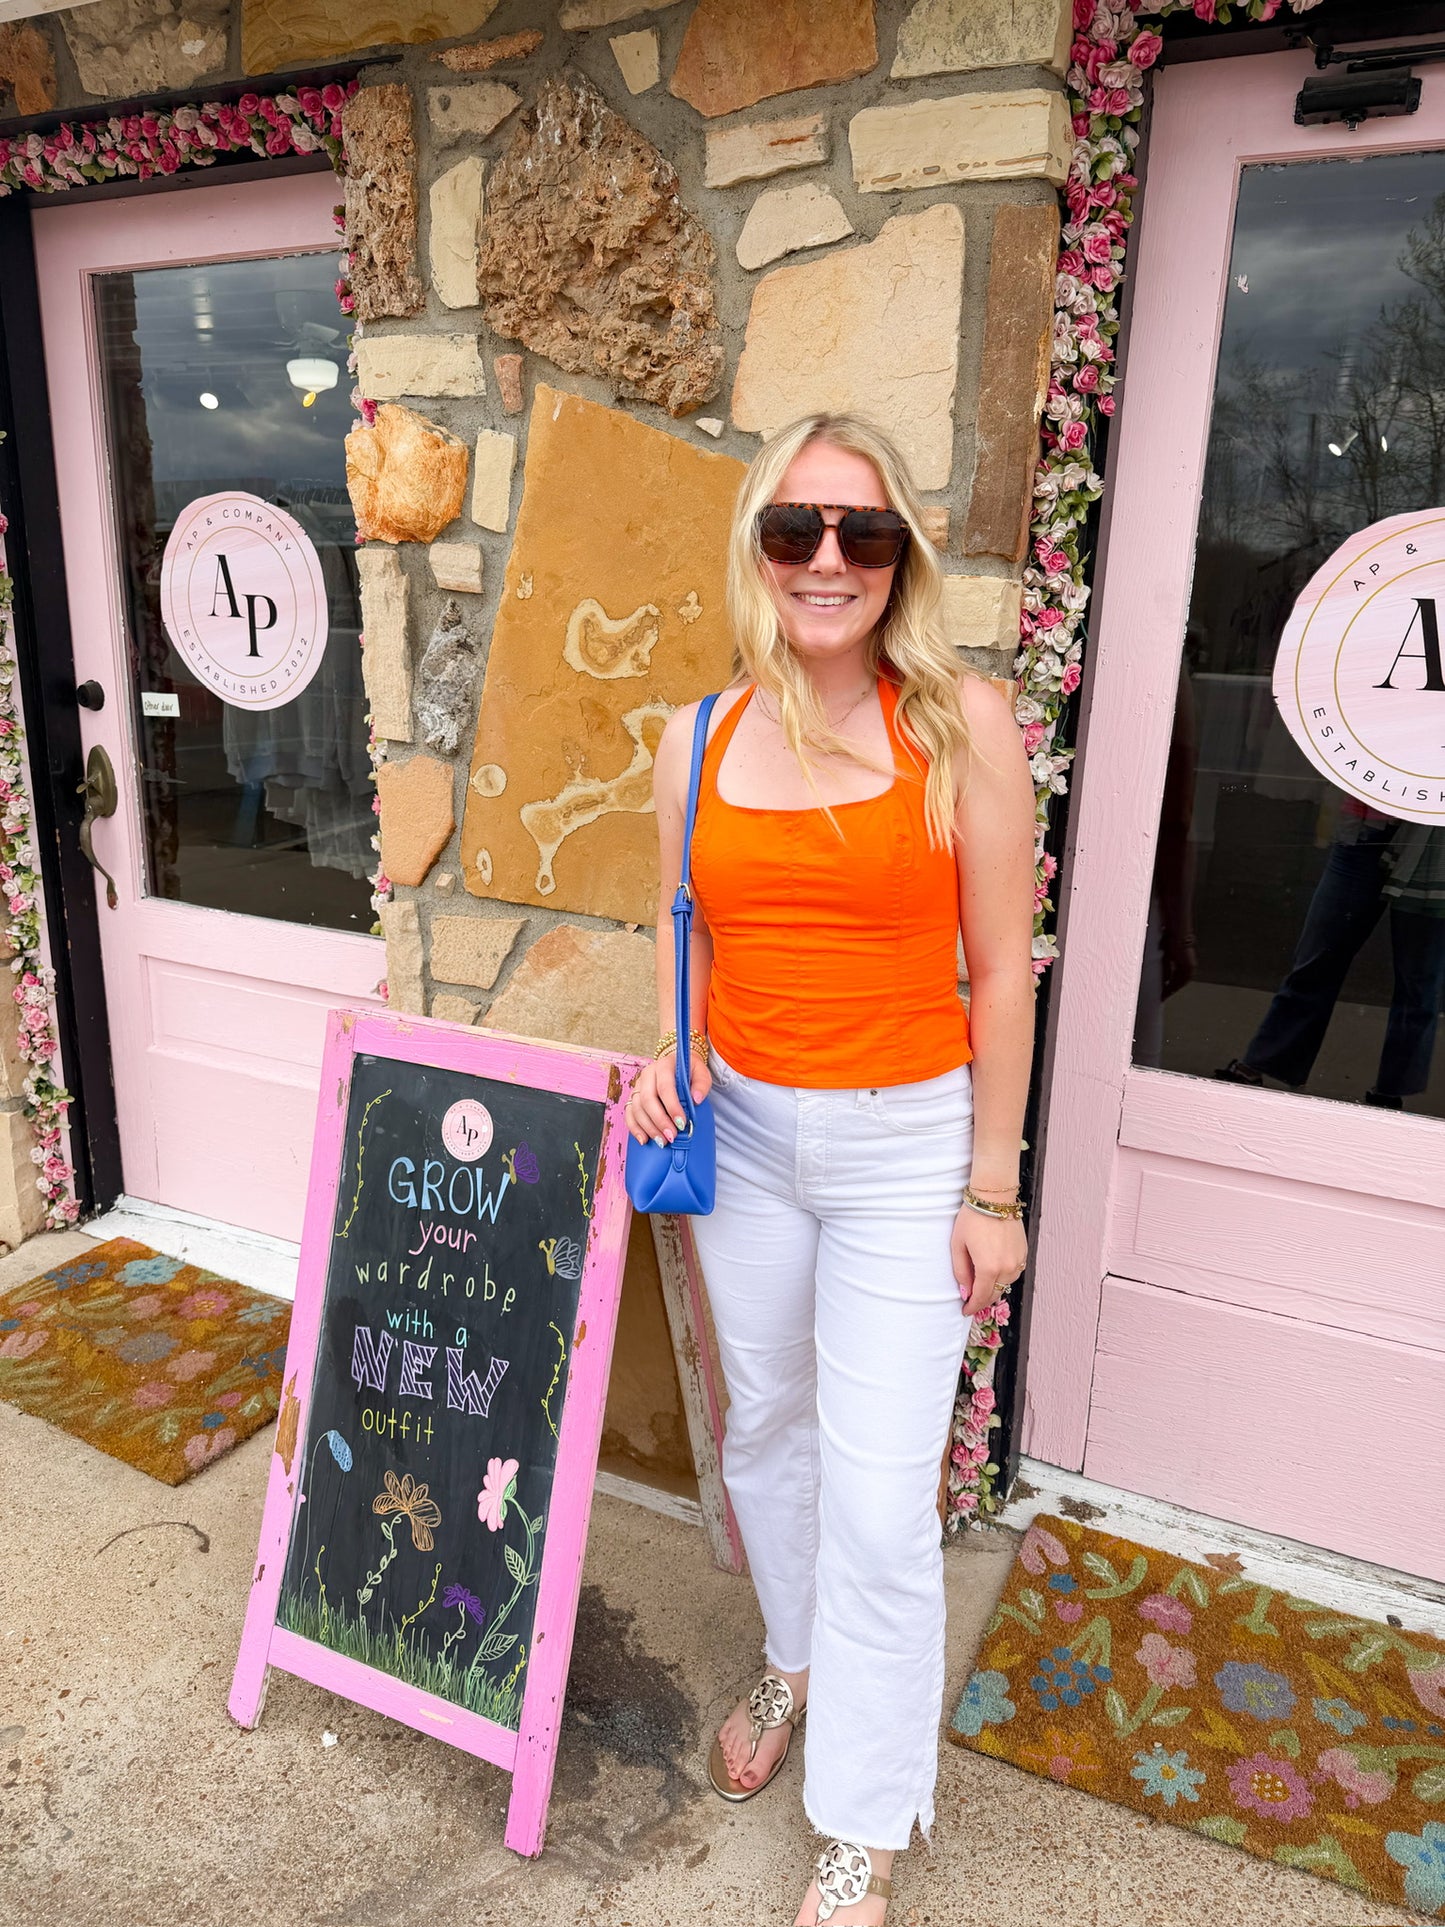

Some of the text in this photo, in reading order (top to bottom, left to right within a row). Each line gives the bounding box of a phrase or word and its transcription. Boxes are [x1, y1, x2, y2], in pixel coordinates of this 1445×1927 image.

[187, 508, 292, 552] AP & COMPANY
[1353, 542, 1418, 592] AP &
[207, 553, 278, 658] AP
[183, 629, 308, 694] ESTABLISHED 2022
[1372, 597, 1445, 693] A
[456, 1115, 479, 1147] AP
[388, 1156, 510, 1224] GROW
[408, 1220, 477, 1255] your
[355, 1256, 516, 1314] wardrobe
[386, 1308, 467, 1348] with a
[351, 1326, 509, 1418] NEW
[361, 1408, 434, 1445] outfit
